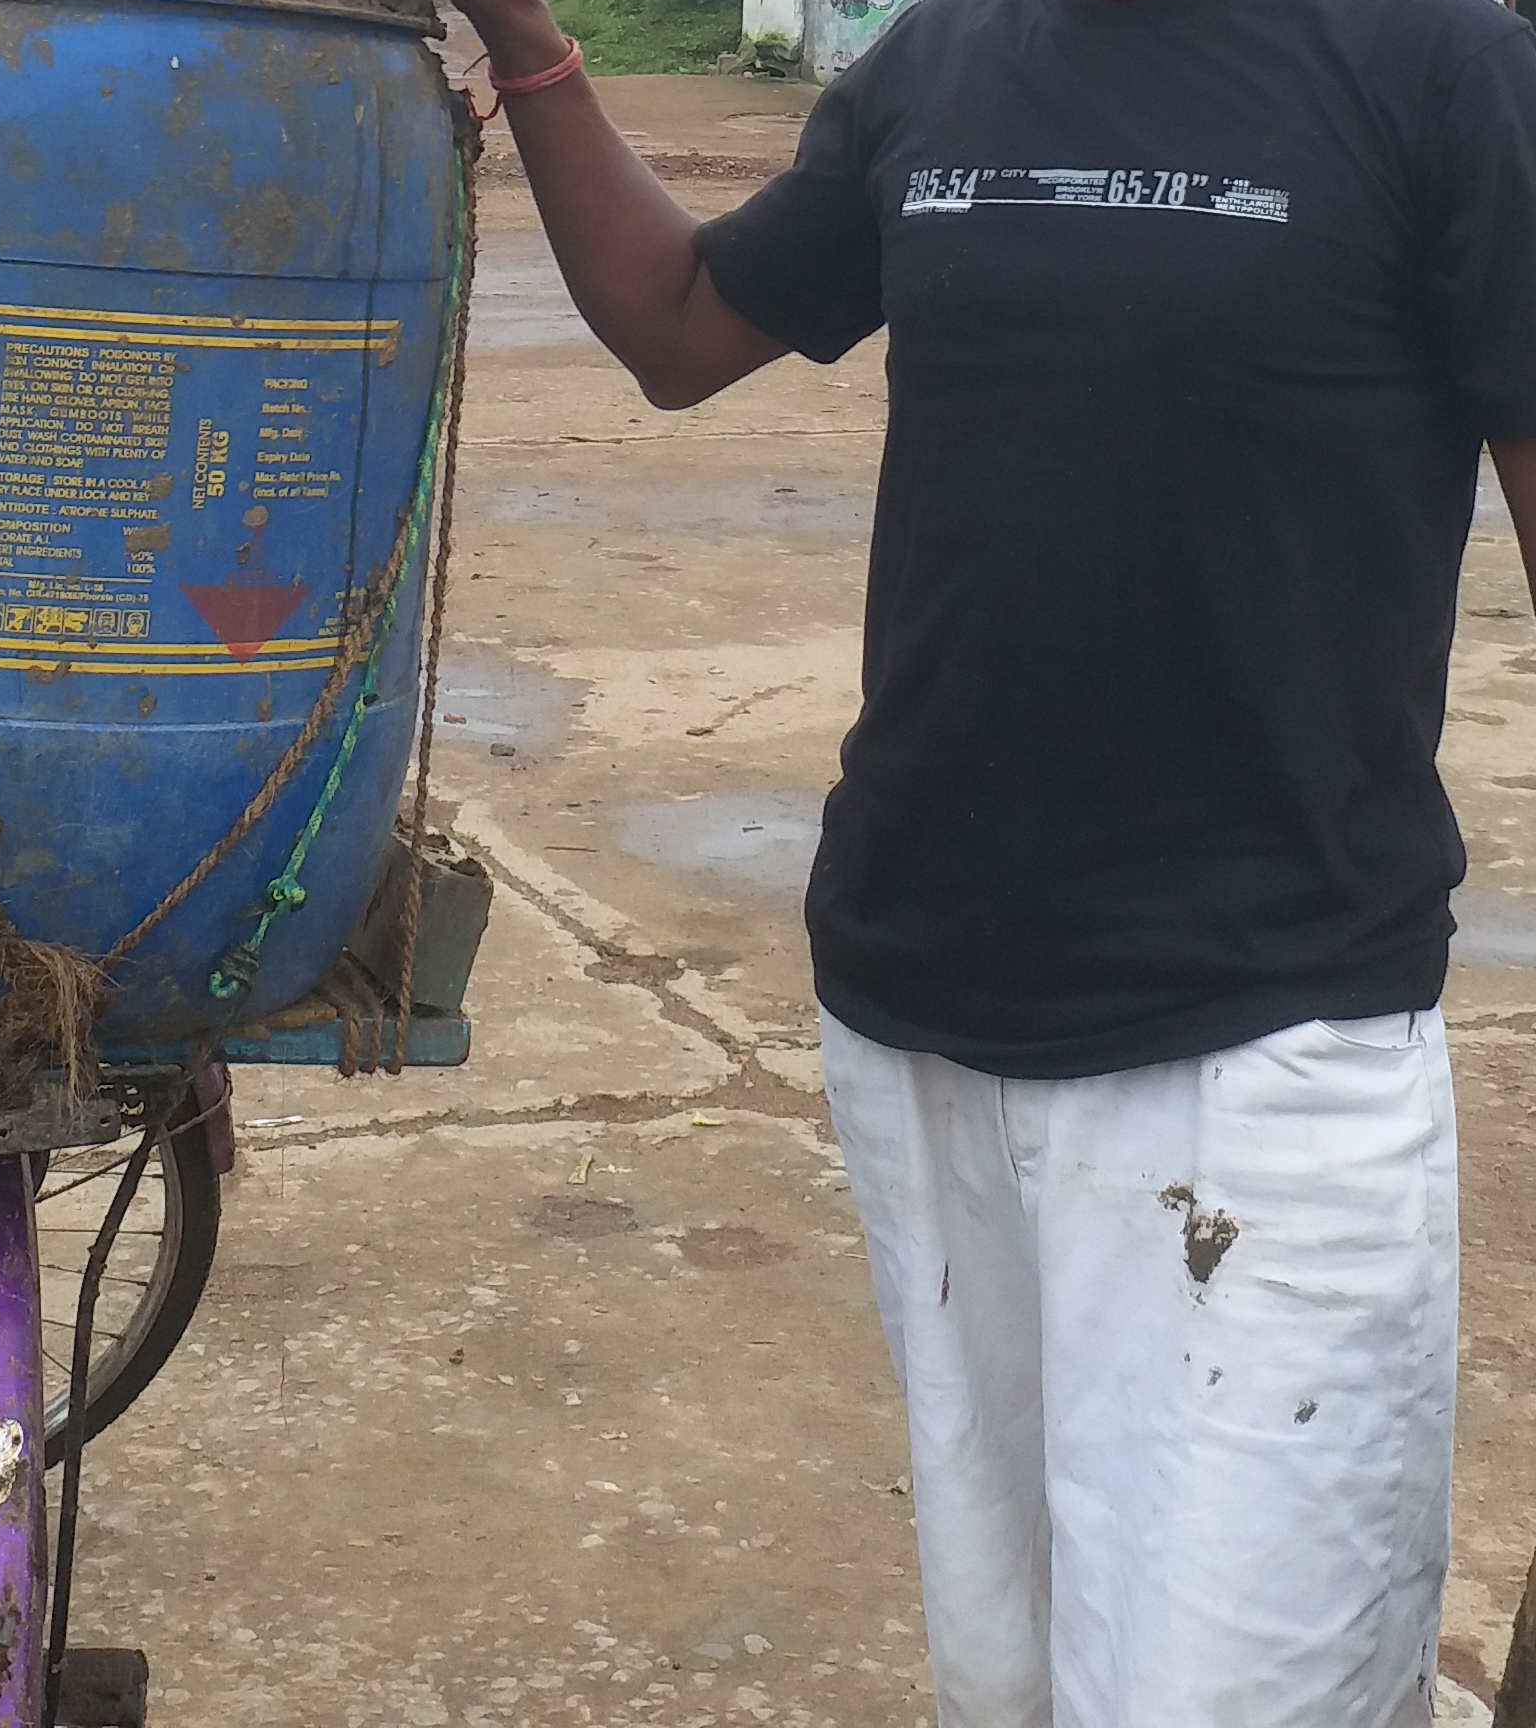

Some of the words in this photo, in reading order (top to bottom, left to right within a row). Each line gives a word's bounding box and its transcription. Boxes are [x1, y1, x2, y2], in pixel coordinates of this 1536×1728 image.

[1000, 168, 1027, 178] CITY
[1054, 193, 1076, 201] NEW
[1055, 185, 1104, 194] BROOKLYN
[1210, 194, 1289, 211] TENTH-LARGEST
[5, 342, 90, 358] PRECAUTIONS
[98, 347, 162, 362] POISONOUS
[163, 351, 177, 362] BY
[91, 360, 153, 374] INHALATION
[158, 363, 175, 374] OR
[79, 371, 97, 383] DO
[100, 372, 123, 384] NOT
[125, 374, 146, 385] GET
[148, 375, 174, 387] INTO
[30, 380, 49, 392] ON
[50, 382, 73, 394] SKIN
[76, 383, 93, 395] OR
[94, 384, 112, 396] ON
[0, 391, 19, 403] USE
[21, 392, 52, 405] HAND
[144, 399, 172, 411] FACE
[49, 407, 122, 421] GUMBOOTS
[132, 412, 171, 423] WHILE
[75, 421, 94, 432] DO
[101, 422, 124, 433] NOT
[132, 424, 170, 435] BREATH
[27, 430, 57, 442] WASH
[60, 432, 142, 447] CONTAMINATED
[145, 437, 168, 448] SKIN
[22, 442, 83, 456] CLOTHINGS
[84, 447, 111, 458] WITH
[113, 448, 149, 460] PLENTY
[150, 449, 167, 460] OF
[195, 418, 213, 484] CONTENTS
[210, 431, 230, 464] KG
[28, 455, 53, 466] AND
[257, 451, 289, 464] Expiry
[289, 452, 311, 463] Date
[52, 475, 83, 487] STORE
[85, 476, 96, 487] IN
[97, 477, 106, 488] A
[107, 478, 137, 489] COOL
[207, 470, 227, 498] 50
[280, 471, 305, 483] Retail
[306, 471, 329, 482] Price
[11, 485, 42, 497] PLACE
[43, 487, 77, 500] UNDER
[79, 490, 107, 501] LOCK
[108, 491, 131, 502] AND
[132, 491, 152, 502] KEY
[192, 485, 207, 510] NET
[278, 486, 290, 497] of
[58, 505, 108, 518] ATROPINE
[15, 545, 83, 560] INGREDIENTS
[125, 562, 156, 574] 100%
